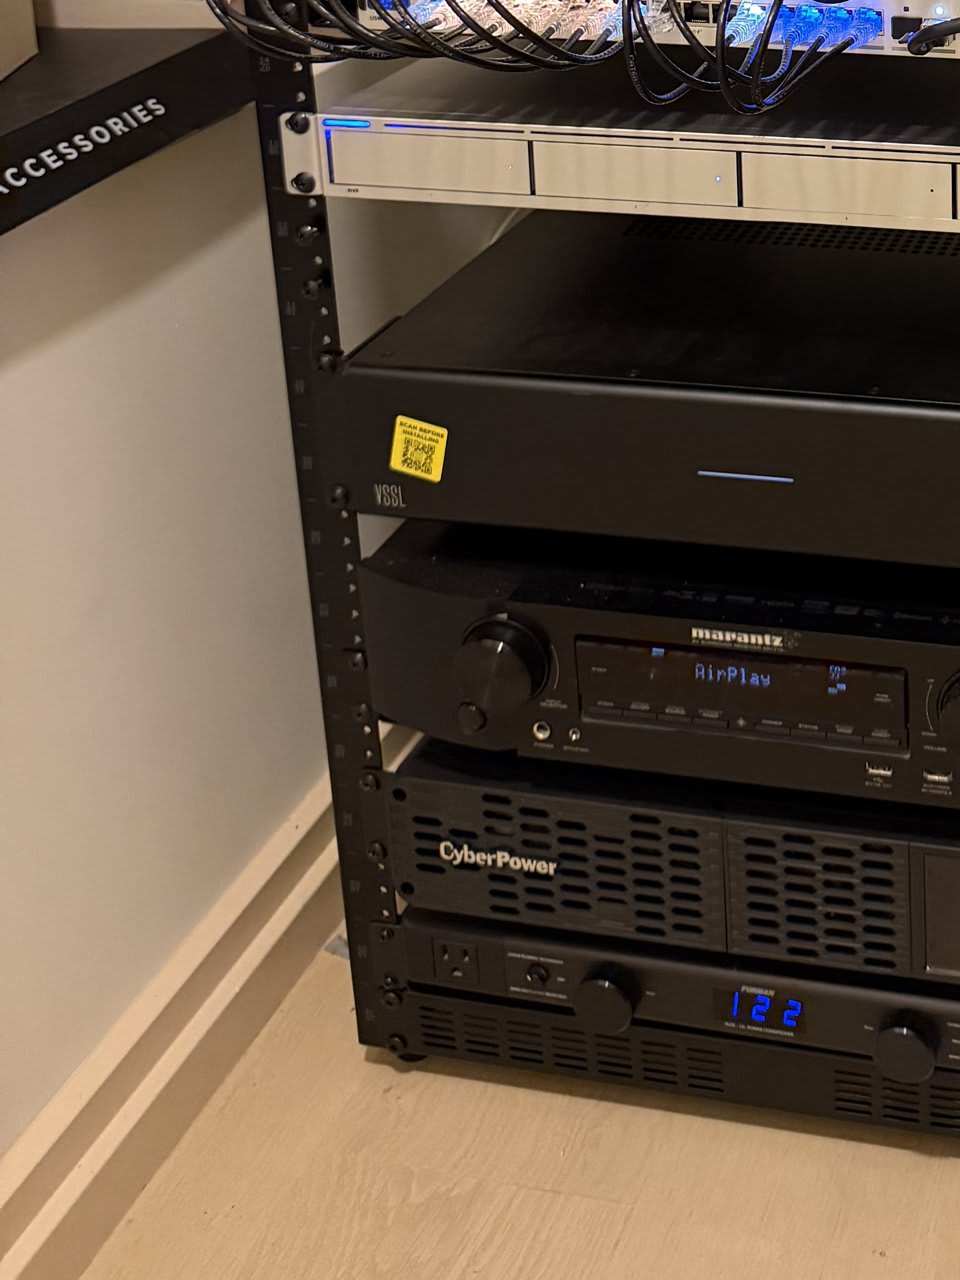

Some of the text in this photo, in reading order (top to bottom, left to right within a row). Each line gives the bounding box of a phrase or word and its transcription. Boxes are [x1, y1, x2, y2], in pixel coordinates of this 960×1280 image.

[399, 420, 445, 439] SCAN BEFORE
[402, 429, 440, 444] INSTALLING
[374, 483, 407, 508] VSSL
[691, 627, 783, 647] marantz
[695, 662, 771, 688] AirPlay
[439, 841, 557, 875] CyberPower
